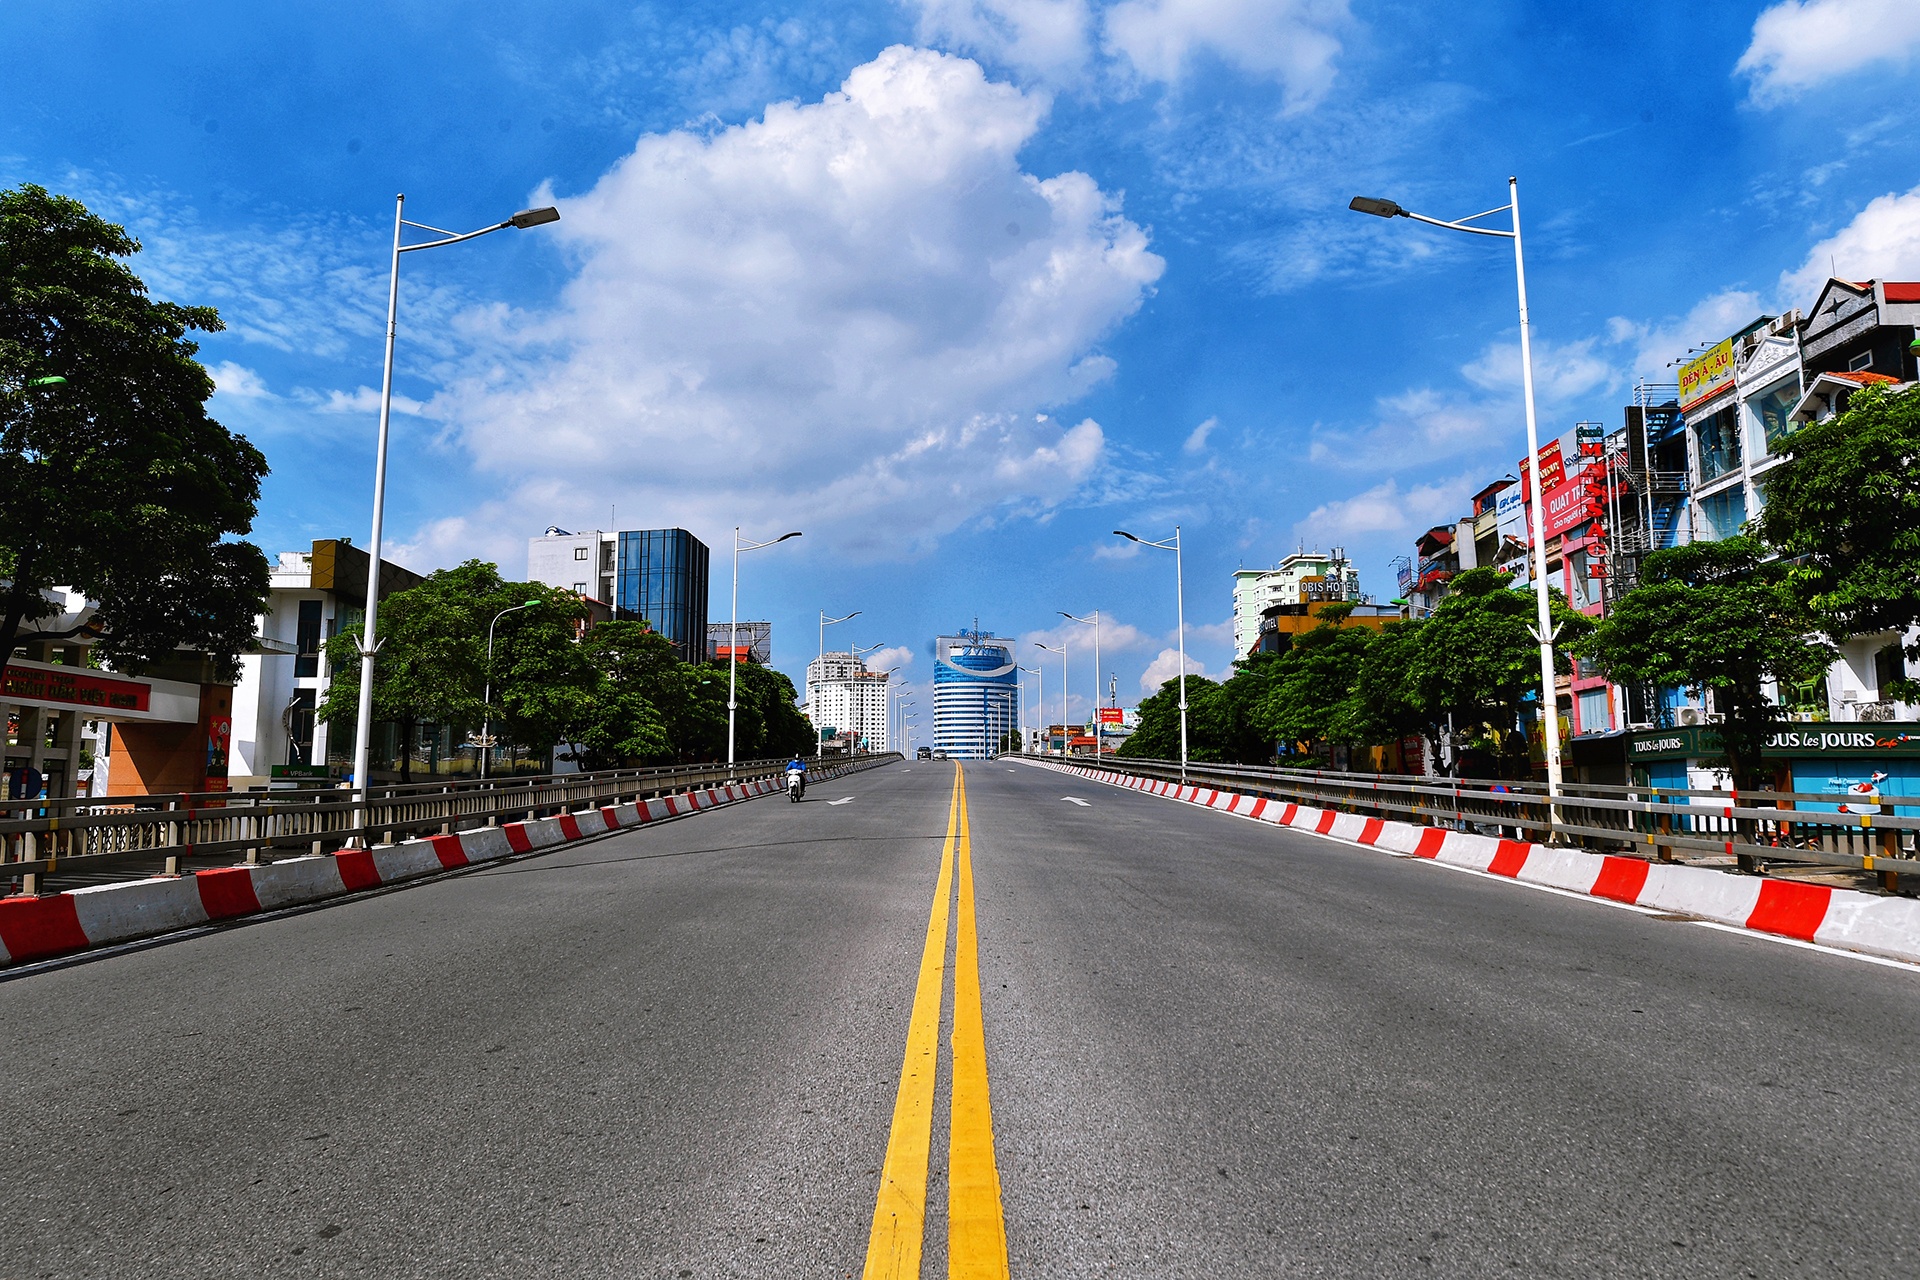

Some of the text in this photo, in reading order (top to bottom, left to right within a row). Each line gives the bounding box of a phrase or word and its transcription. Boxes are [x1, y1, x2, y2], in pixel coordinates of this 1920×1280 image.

[1682, 369, 1700, 388] ĐÈN
[1701, 362, 1709, 377] Á
[1715, 353, 1728, 369] ÂU
[1550, 491, 1570, 514] QUẠT
[1580, 443, 1608, 578] MASSAGE
[1554, 519, 1563, 529] cho
[1301, 581, 1358, 592] OBIS HOTEL
[1634, 741, 1652, 752] TOUS
[1658, 738, 1681, 752] JOURS
[1766, 733, 1800, 747] OUS
[1803, 733, 1819, 747] les
[1819, 733, 1875, 750] JOURS
